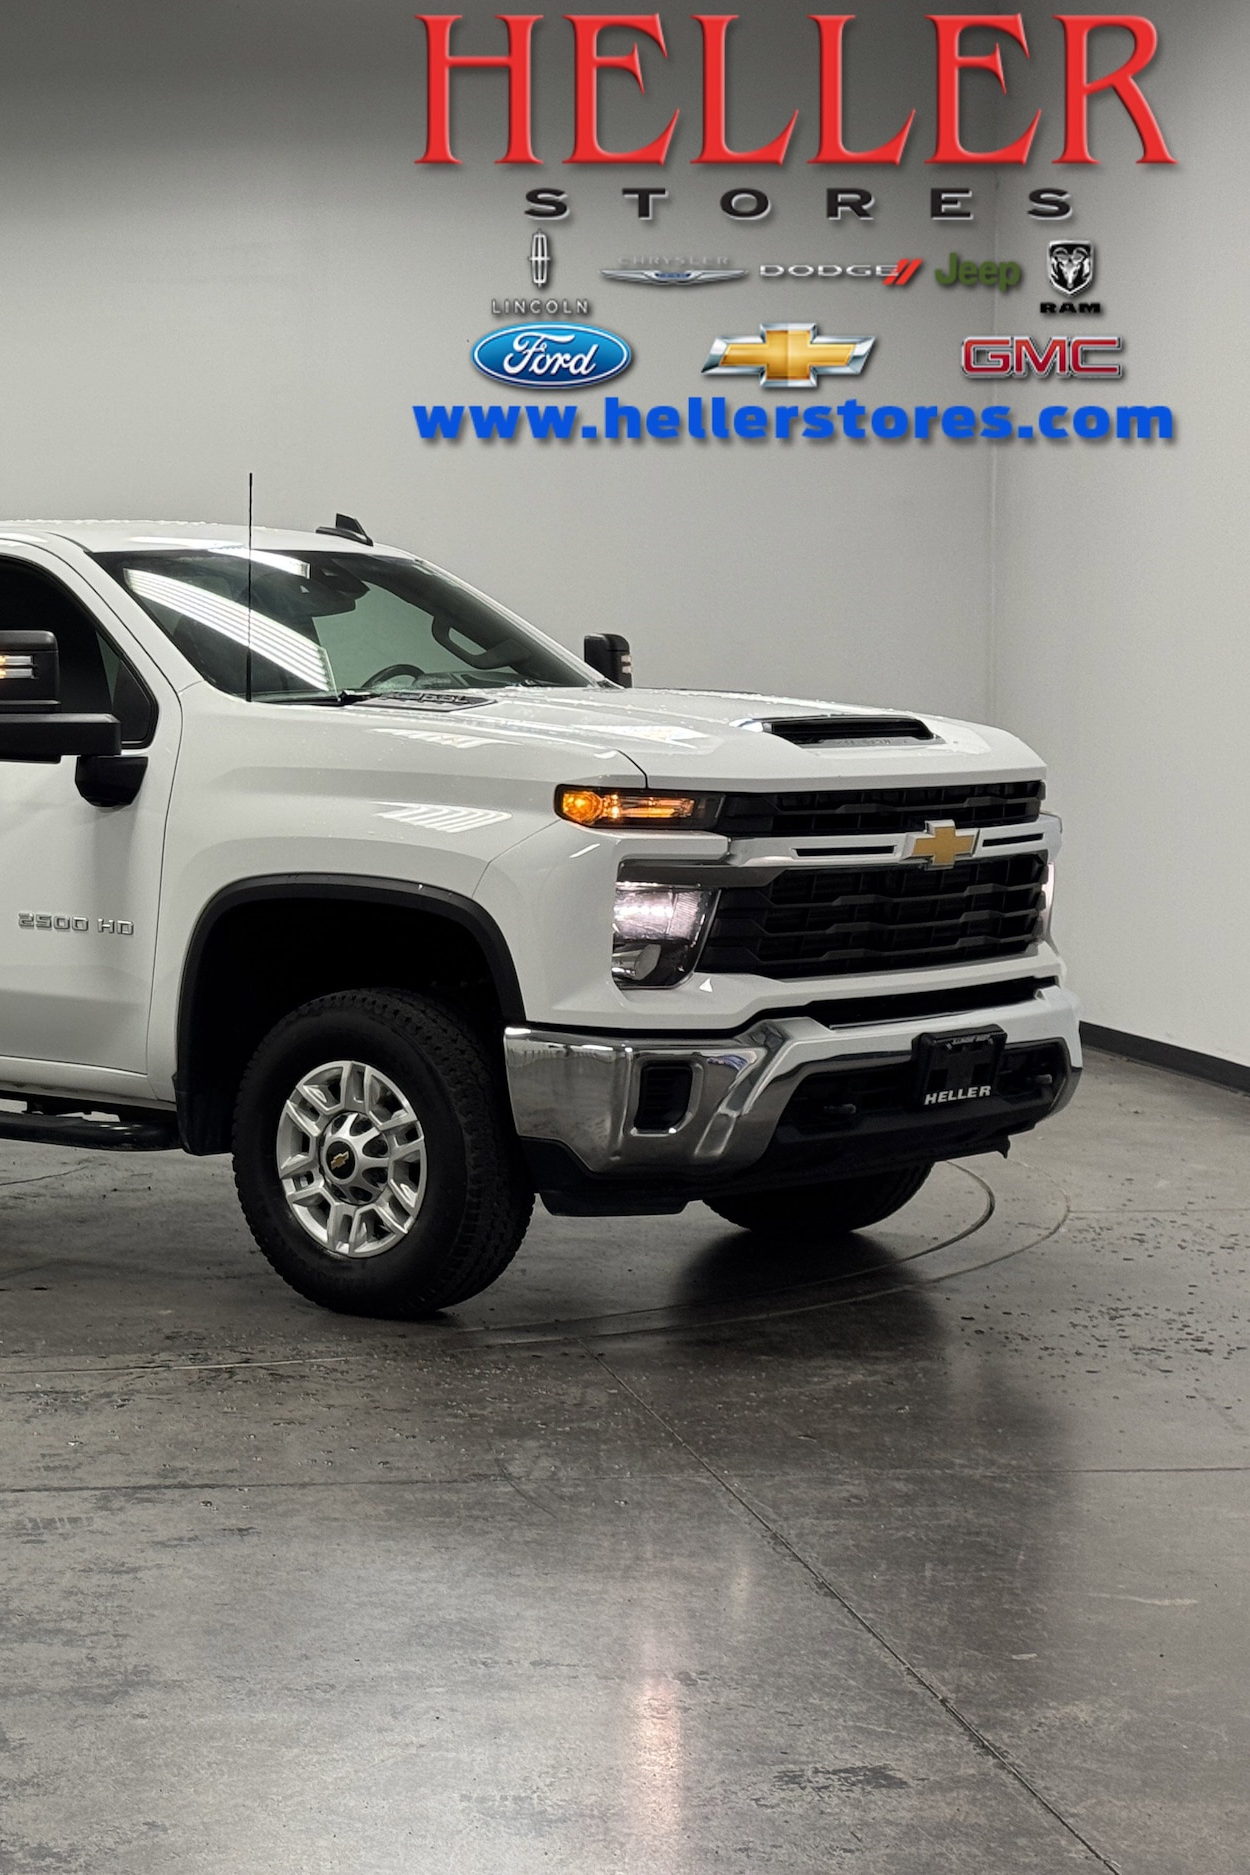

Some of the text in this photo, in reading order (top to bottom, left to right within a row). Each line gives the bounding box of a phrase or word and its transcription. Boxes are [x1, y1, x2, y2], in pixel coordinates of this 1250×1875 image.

[18, 912, 134, 935] 2500 HD
[924, 1085, 991, 1105] HELLER
